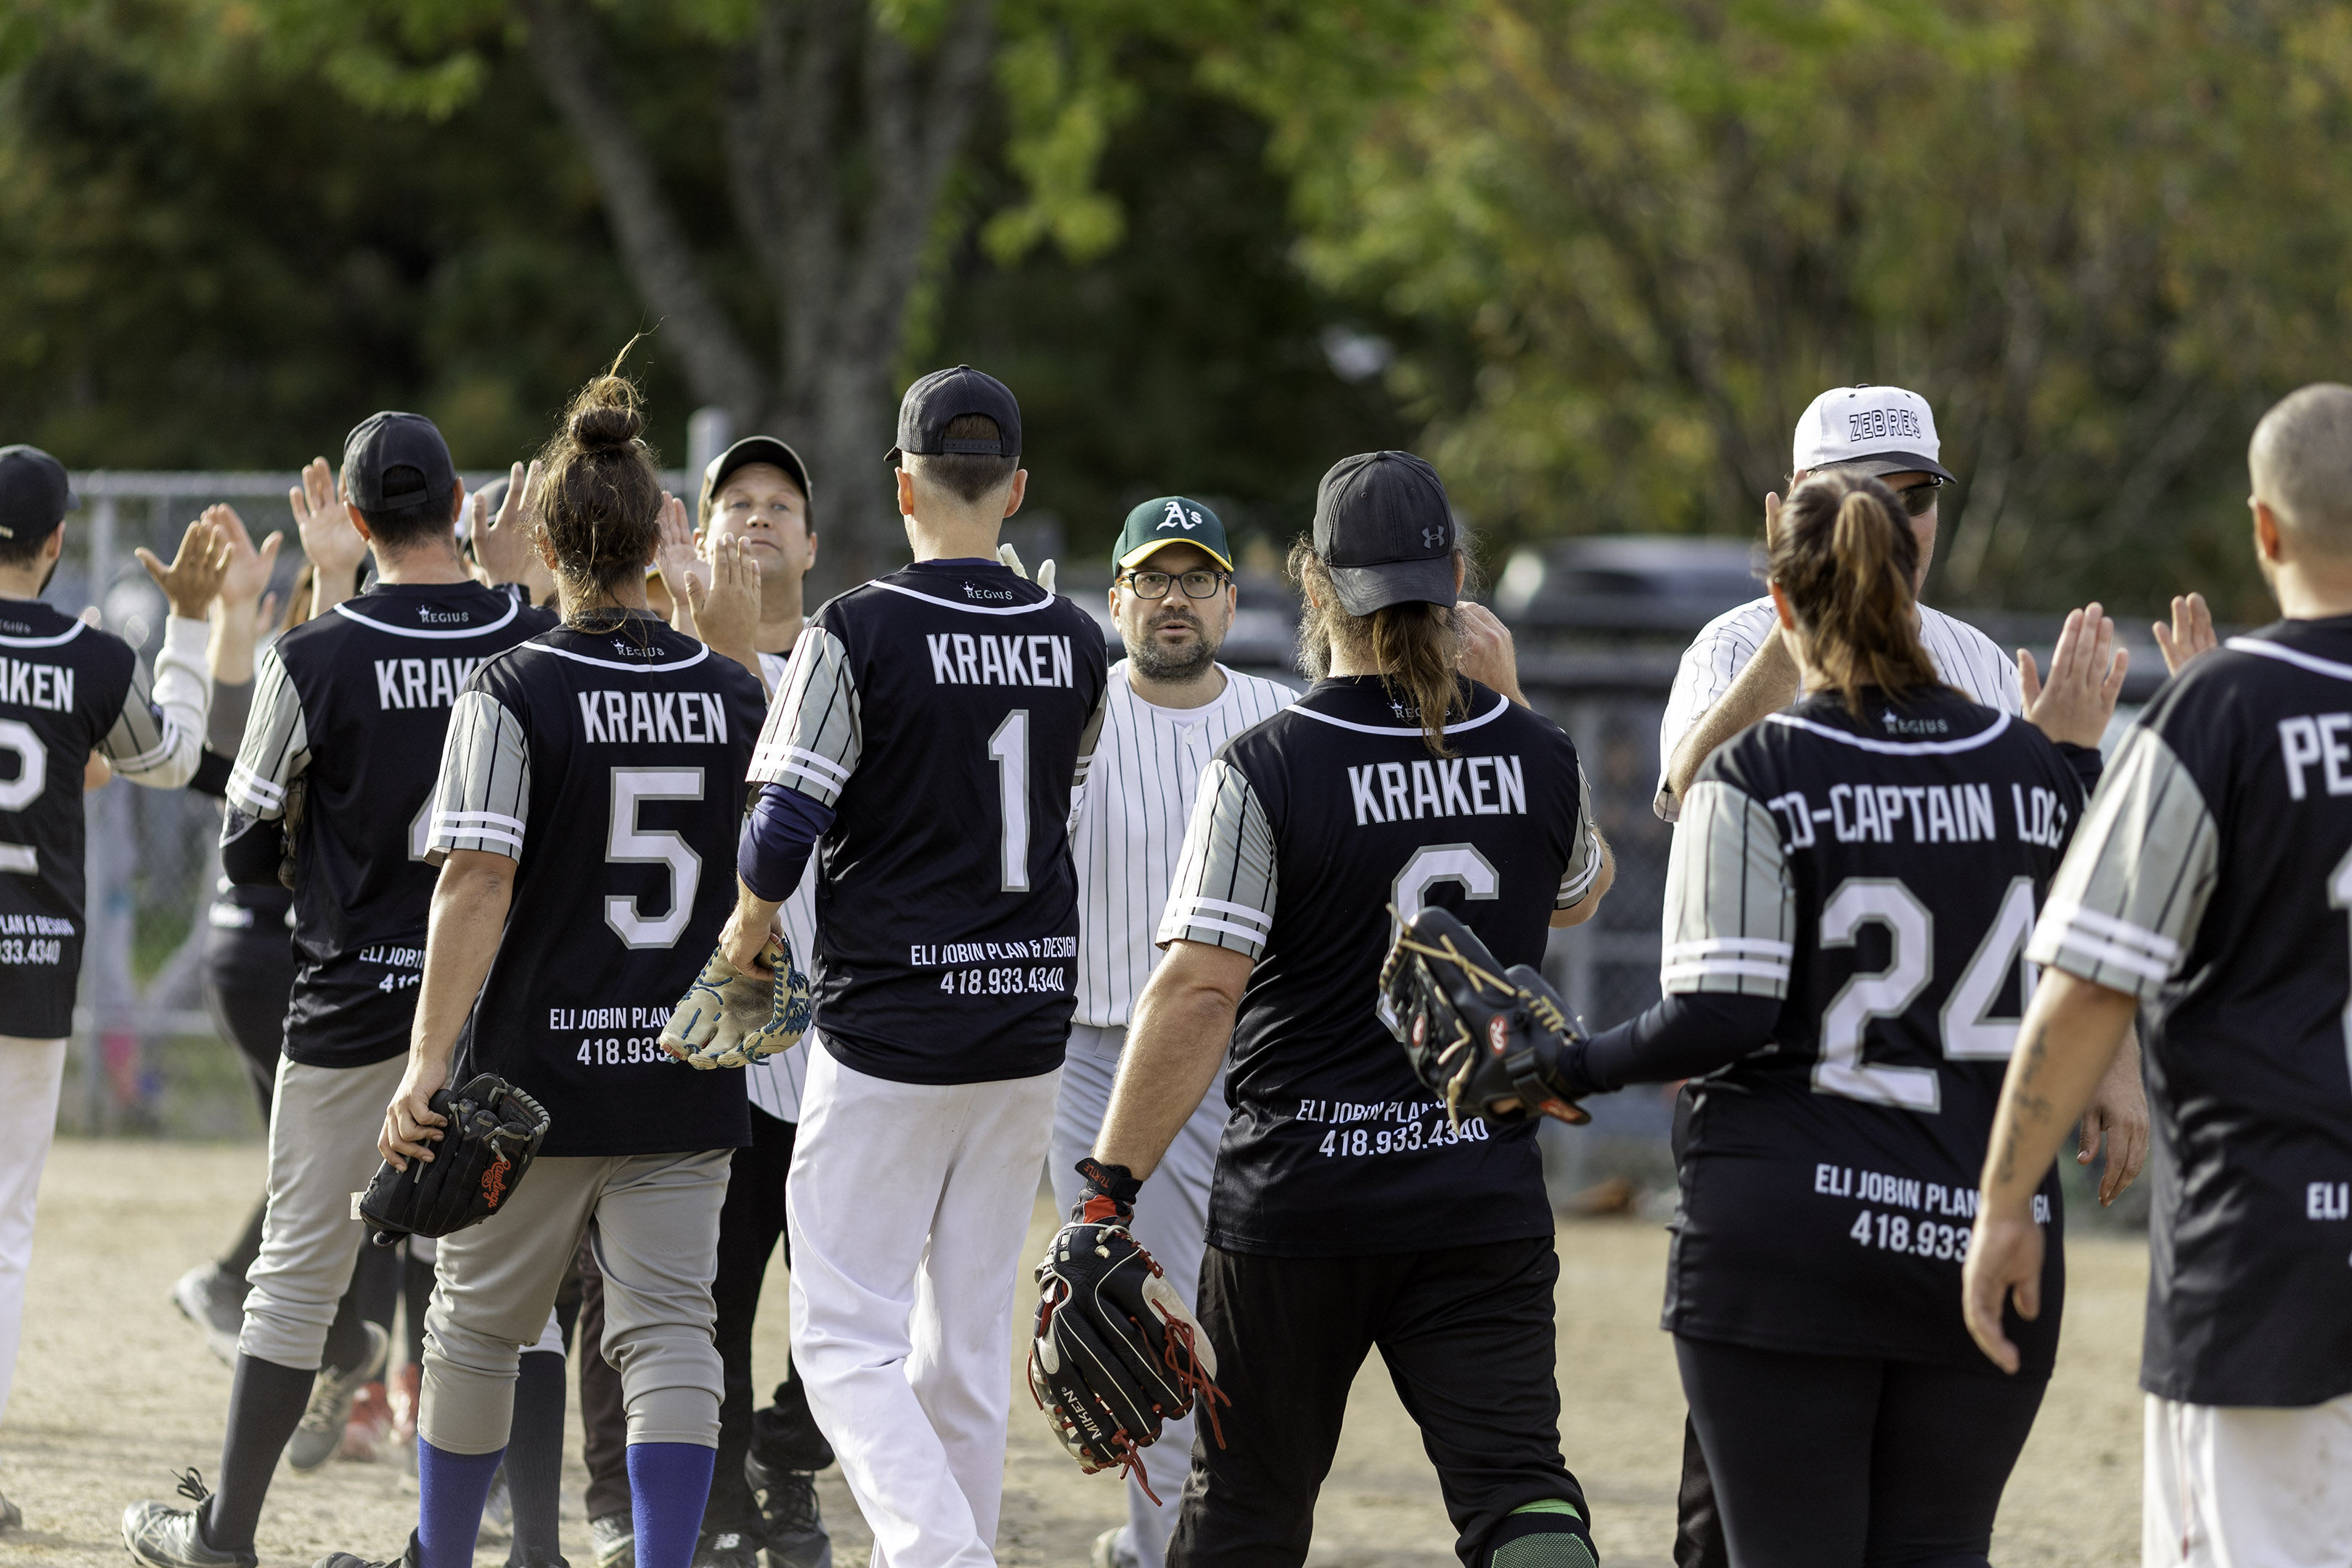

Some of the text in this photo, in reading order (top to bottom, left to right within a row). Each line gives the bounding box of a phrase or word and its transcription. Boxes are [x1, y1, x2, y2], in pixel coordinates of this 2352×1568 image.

[1849, 409, 1921, 441] ZEBRES
[1156, 501, 1202, 531] A's
[966, 589, 1013, 600] REGIUS
[421, 612, 469, 623] REGIUS
[617, 647, 664, 656] REGIUS
[926, 634, 1073, 688] KRAKEN
[374, 657, 488, 710] KRAK
[578, 690, 727, 744] KRAKEN
[988, 709, 1030, 892] 1
[1347, 755, 1527, 825] KRAKEN
[605, 767, 704, 950] 5
[0, 939, 61, 965] 33.4340
[911, 936, 1076, 965] ELI JOBIN PLAN & DESIGN
[940, 967, 1065, 995] 418.933.4340
[1811, 875, 2040, 1114] 24
[550, 1008, 575, 1030] ELI
[579, 1008, 626, 1029] JOBIN
[1296, 1100, 1326, 1122] ELI
[1319, 1116, 1490, 1157] 418.933.4340
[1083, 1162, 1110, 1188] TURTLE
[1815, 1163, 1981, 1218] ELI JOBIN PLAN
[2307, 1181, 2349, 1220] ELI
[1063, 1389, 1103, 1440] MIKEN
